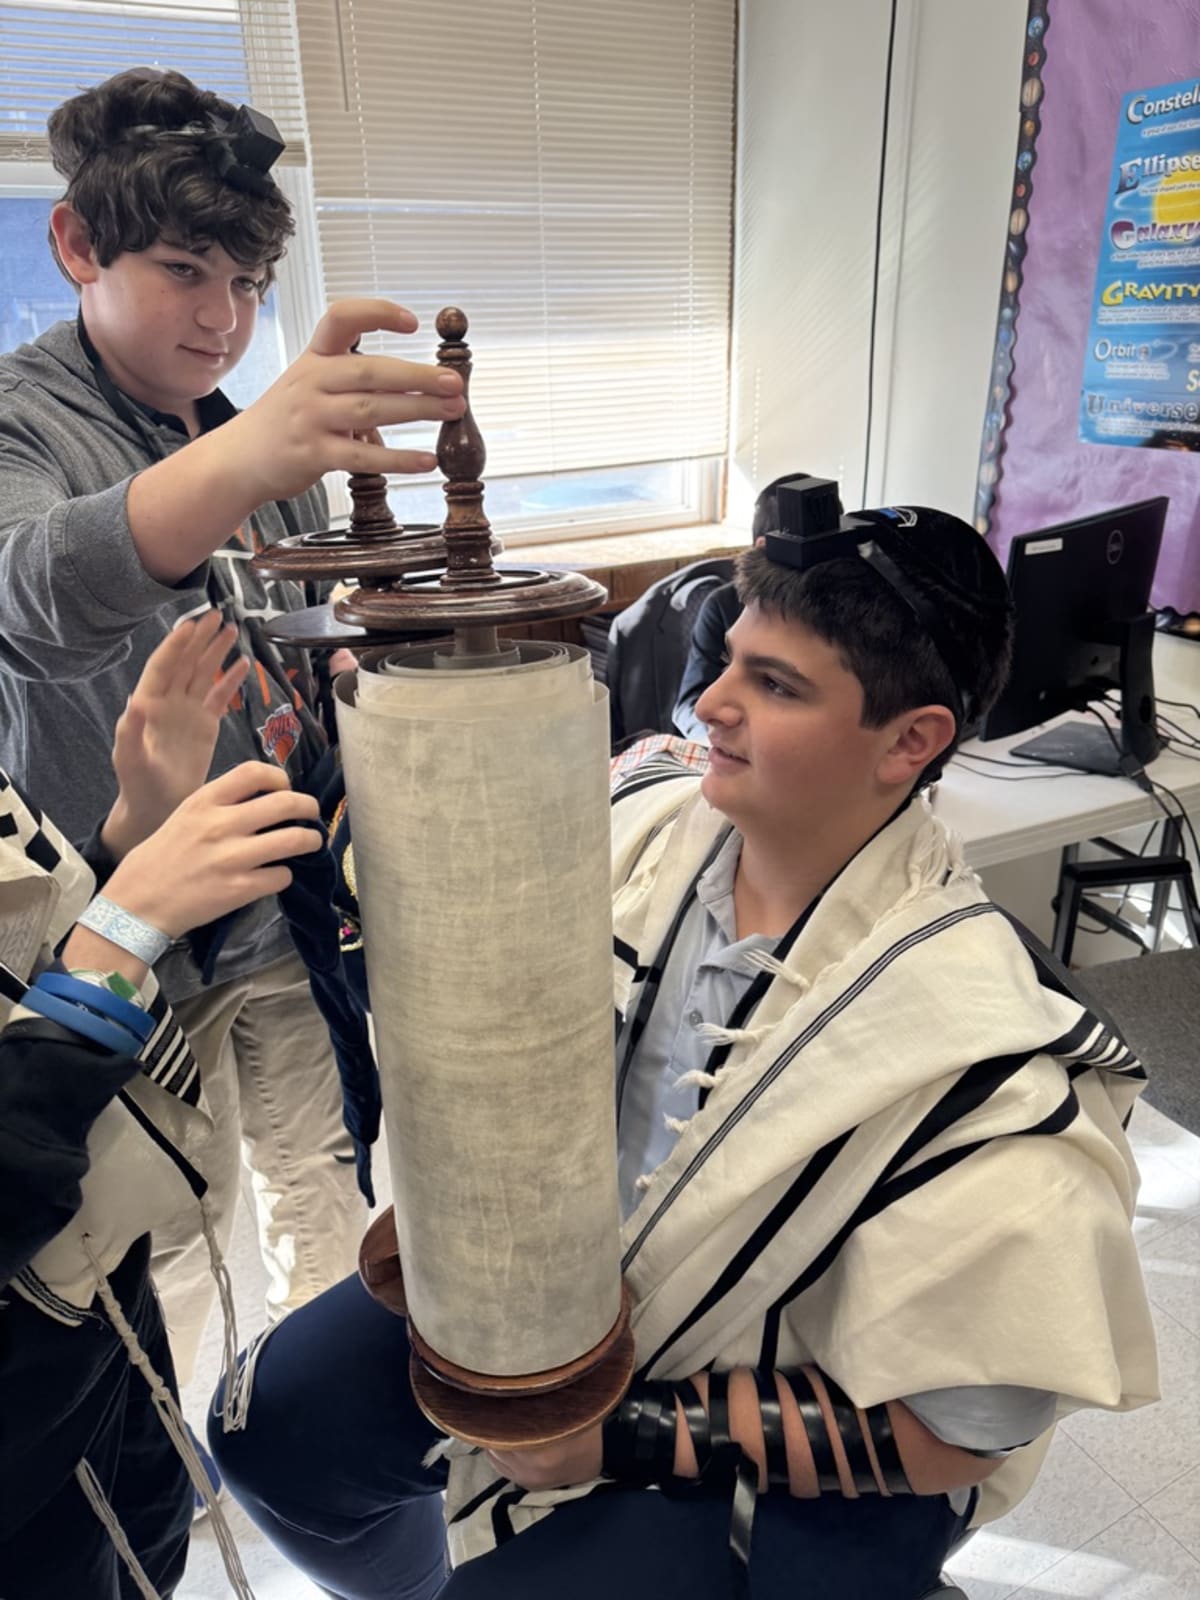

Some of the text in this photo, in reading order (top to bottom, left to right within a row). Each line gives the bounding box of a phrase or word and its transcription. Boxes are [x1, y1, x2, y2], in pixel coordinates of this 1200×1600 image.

[1126, 84, 1200, 124] Constel
[1115, 153, 1200, 195] Ellipse
[1111, 220, 1200, 251] Galaxy
[1102, 280, 1200, 306] GRAVITY
[1094, 338, 1136, 360] Orbit
[1186, 369, 1200, 393] S
[1087, 393, 1199, 421] Universe
